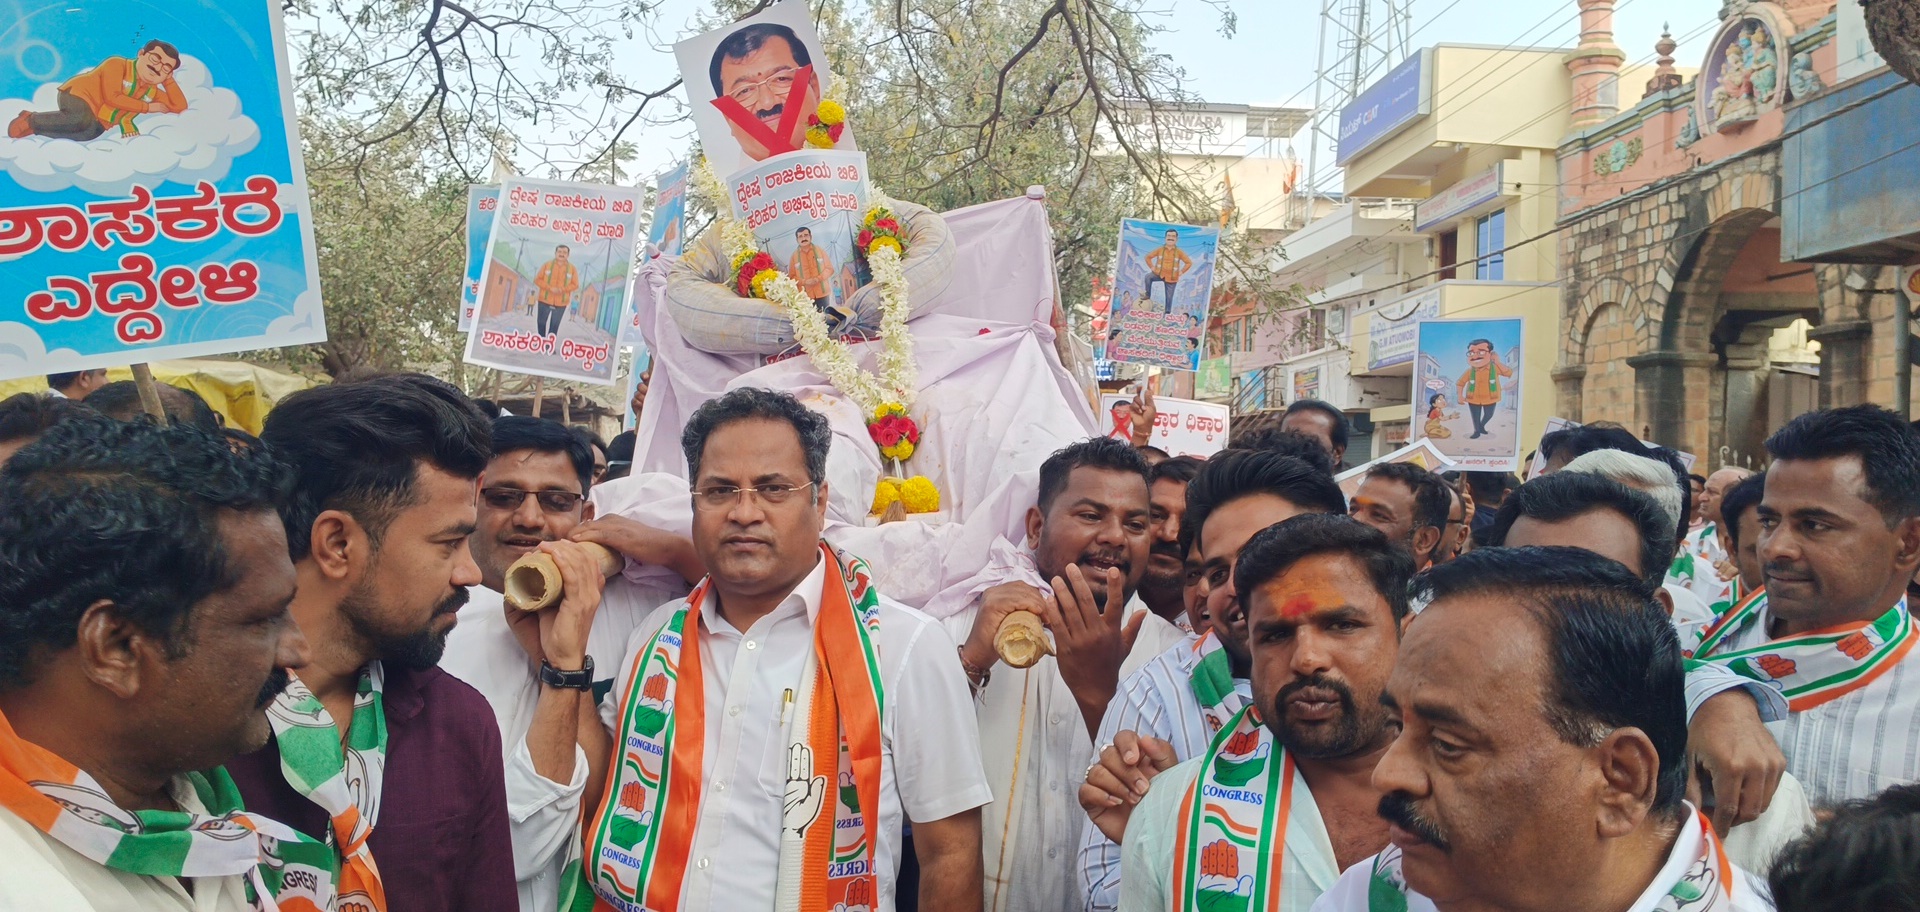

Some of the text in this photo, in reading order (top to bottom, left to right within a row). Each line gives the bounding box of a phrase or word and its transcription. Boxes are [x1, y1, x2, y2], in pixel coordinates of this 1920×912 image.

[509, 186, 633, 214] ದ್ವೇಷ ರಾಜಕೀಯ ಬಿಡಿ
[737, 161, 858, 211] ದ್ವೇಷ ರಾಜಕೀಯ ಬಿಡಿ
[0, 177, 281, 254] ಶಾಸಕರೆ
[747, 191, 858, 229] ಹರಿಹರ ಅಭಿವೃದ್ಧಿ ಮಾಡಿ
[510, 211, 625, 245] ಹರಿಹರ ಅಭಿವೃದ್ಧಿ ಮಾಡಿ
[27, 254, 258, 342] ಎದ್ದೇಳಿ
[482, 330, 609, 370] ಶಾಸಕರಿಗೆ ಧಿಕ್ಕಾರ
[1153, 410, 1224, 442] ಕ್ಕಾರ ಧಿಕ್ಕಾರ
[627, 736, 664, 757] CONGRESS
[1202, 784, 1263, 805] CONGRESS
[602, 846, 641, 869] CONGRESS
